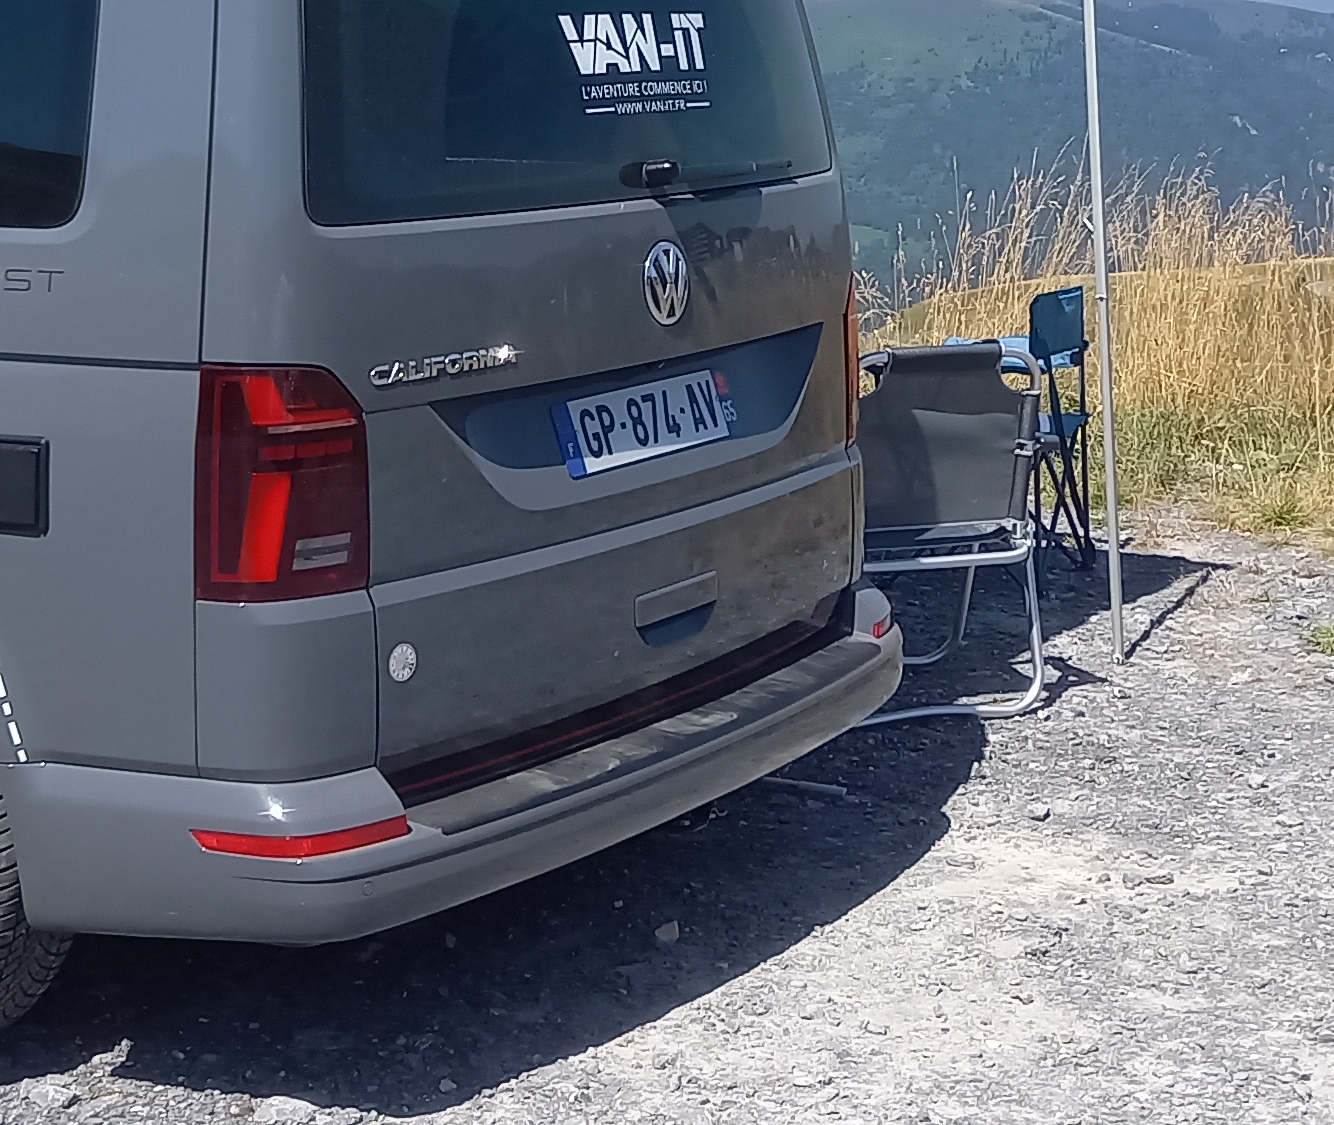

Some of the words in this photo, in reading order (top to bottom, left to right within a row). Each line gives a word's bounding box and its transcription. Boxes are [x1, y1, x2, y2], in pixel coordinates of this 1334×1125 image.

[581, 82, 641, 100] L'AVENTURE
[641, 80, 692, 95] COMMENCE
[579, 379, 719, 459] GP-874-AV
